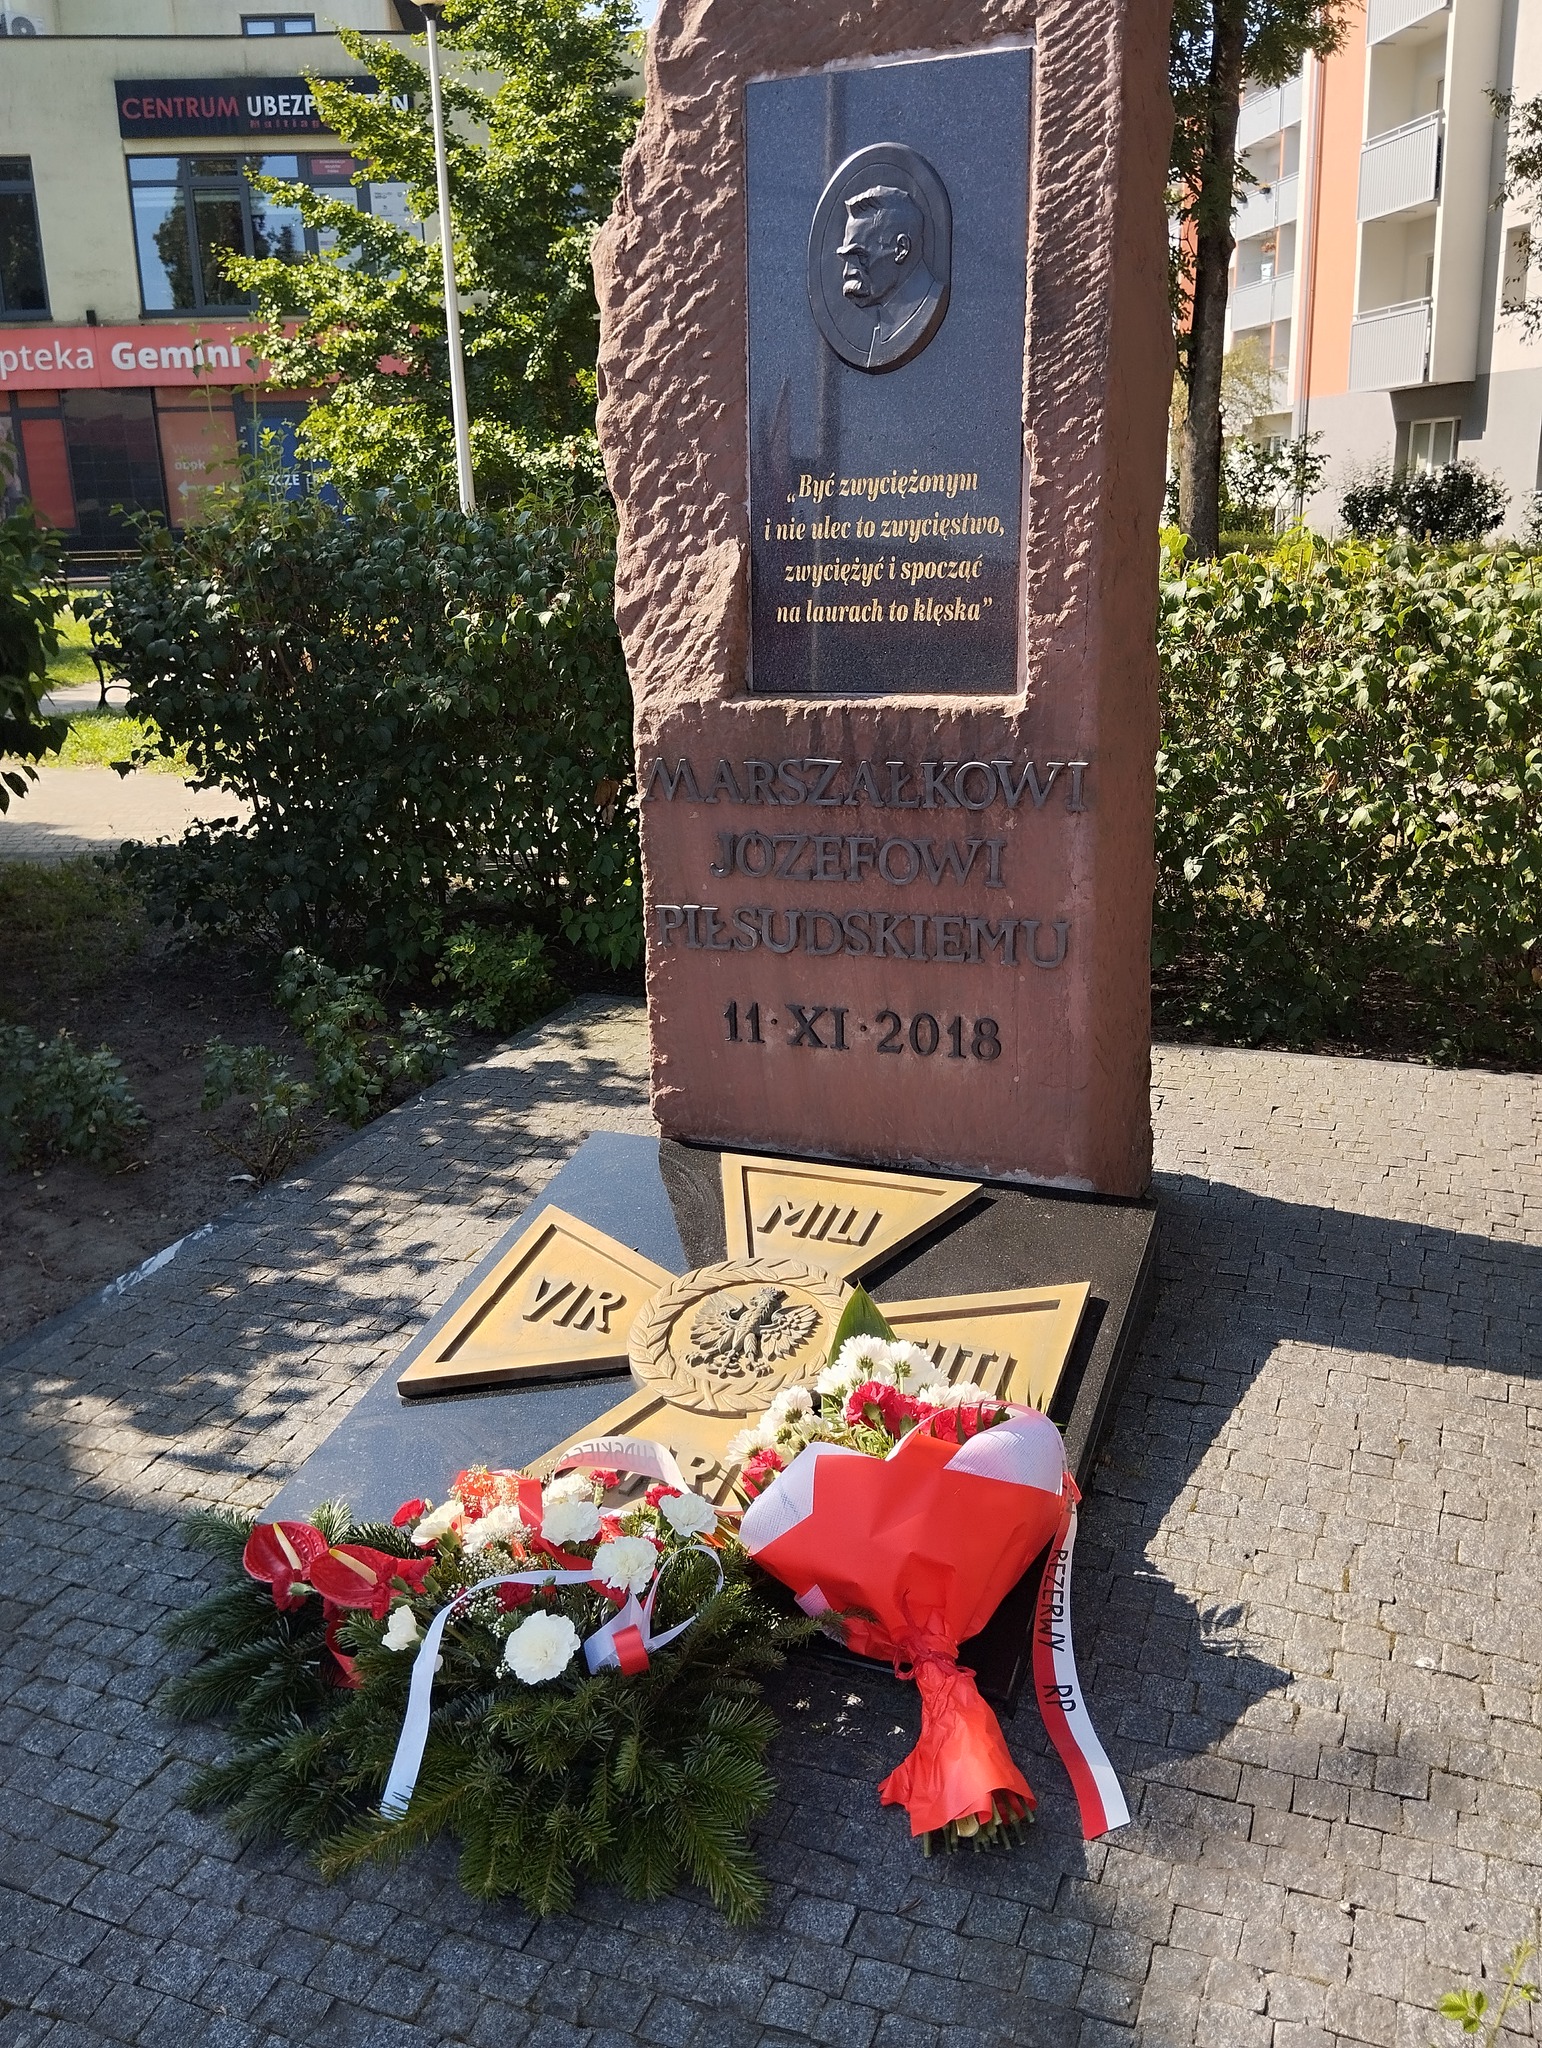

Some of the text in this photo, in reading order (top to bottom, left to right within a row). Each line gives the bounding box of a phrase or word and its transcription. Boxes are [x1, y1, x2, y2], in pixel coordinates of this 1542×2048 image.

[121, 96, 240, 119] CENTRUM
[0, 338, 241, 380] pteka Gemini
[839, 469, 979, 502] zwyciężonym
[764, 511, 1005, 543] i nie ulec to zwycięstwo,
[785, 553, 984, 588] zwyciężyć i spocząć
[776, 604, 801, 623] na
[806, 598, 884, 624] laurach
[888, 599, 909, 623] to
[643, 756, 1090, 813] MARSZAŁKOWI
[654, 903, 1072, 969] PIŁSUDSKIEMU
[756, 1195, 883, 1247] MILI
[521, 1275, 628, 1334] VIR
[1037, 1549, 1077, 1713] REZERWY RP
